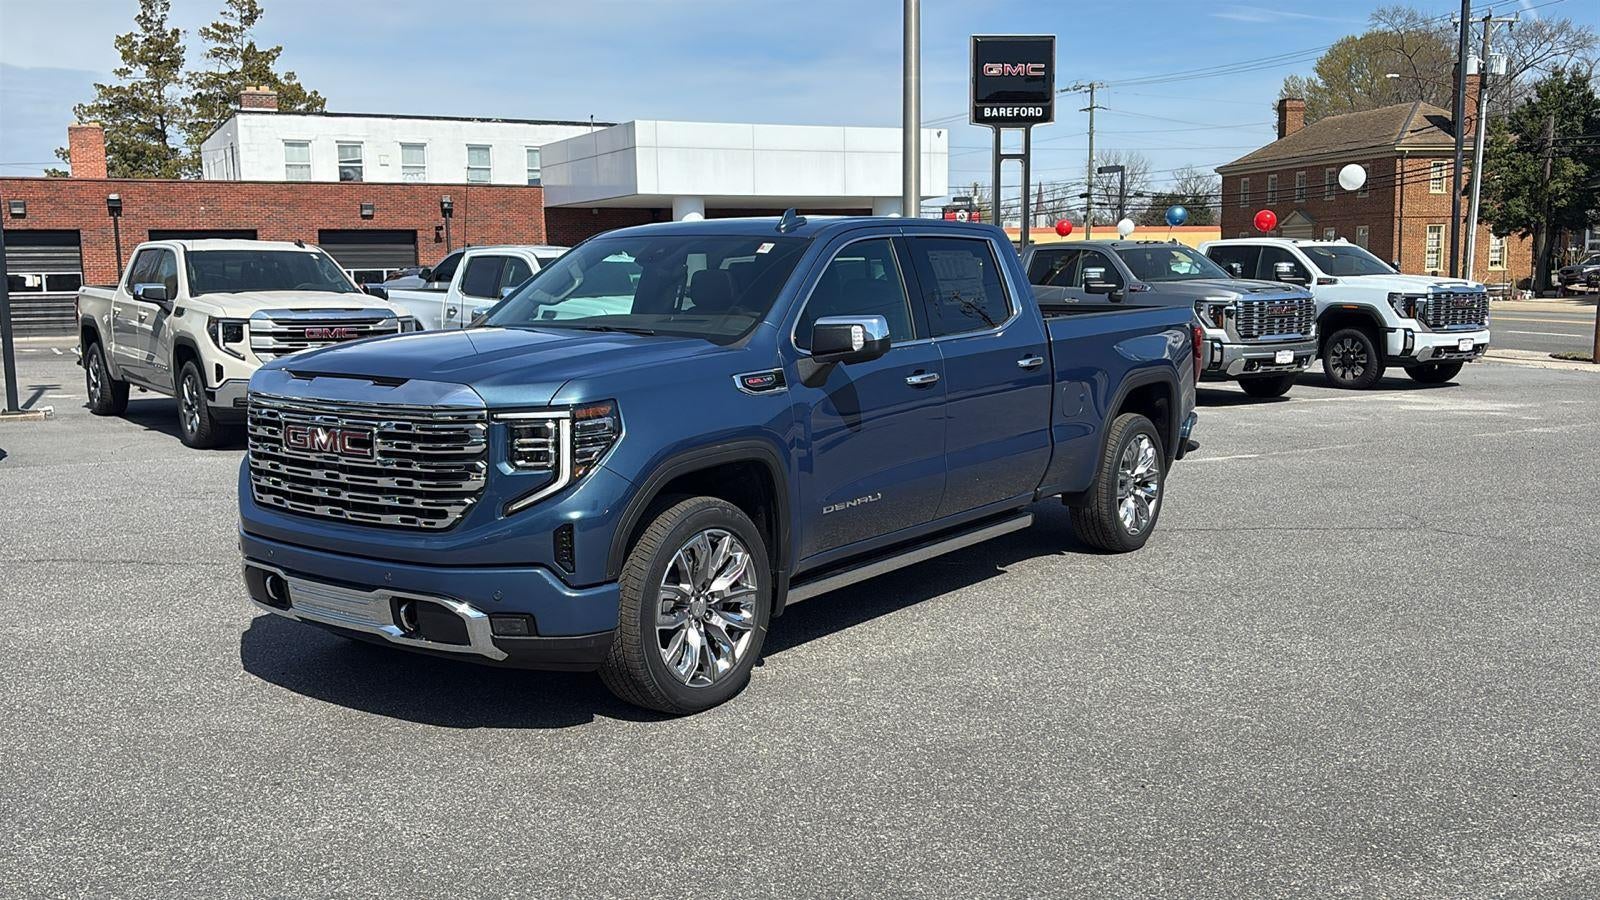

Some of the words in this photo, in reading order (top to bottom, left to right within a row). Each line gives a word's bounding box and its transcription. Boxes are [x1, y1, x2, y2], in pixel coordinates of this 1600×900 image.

[983, 63, 1045, 76] GMC
[984, 107, 1043, 117] BAREFORD
[305, 327, 358, 339] GMC
[285, 425, 371, 456] GMC
[822, 492, 882, 515] DENALI
